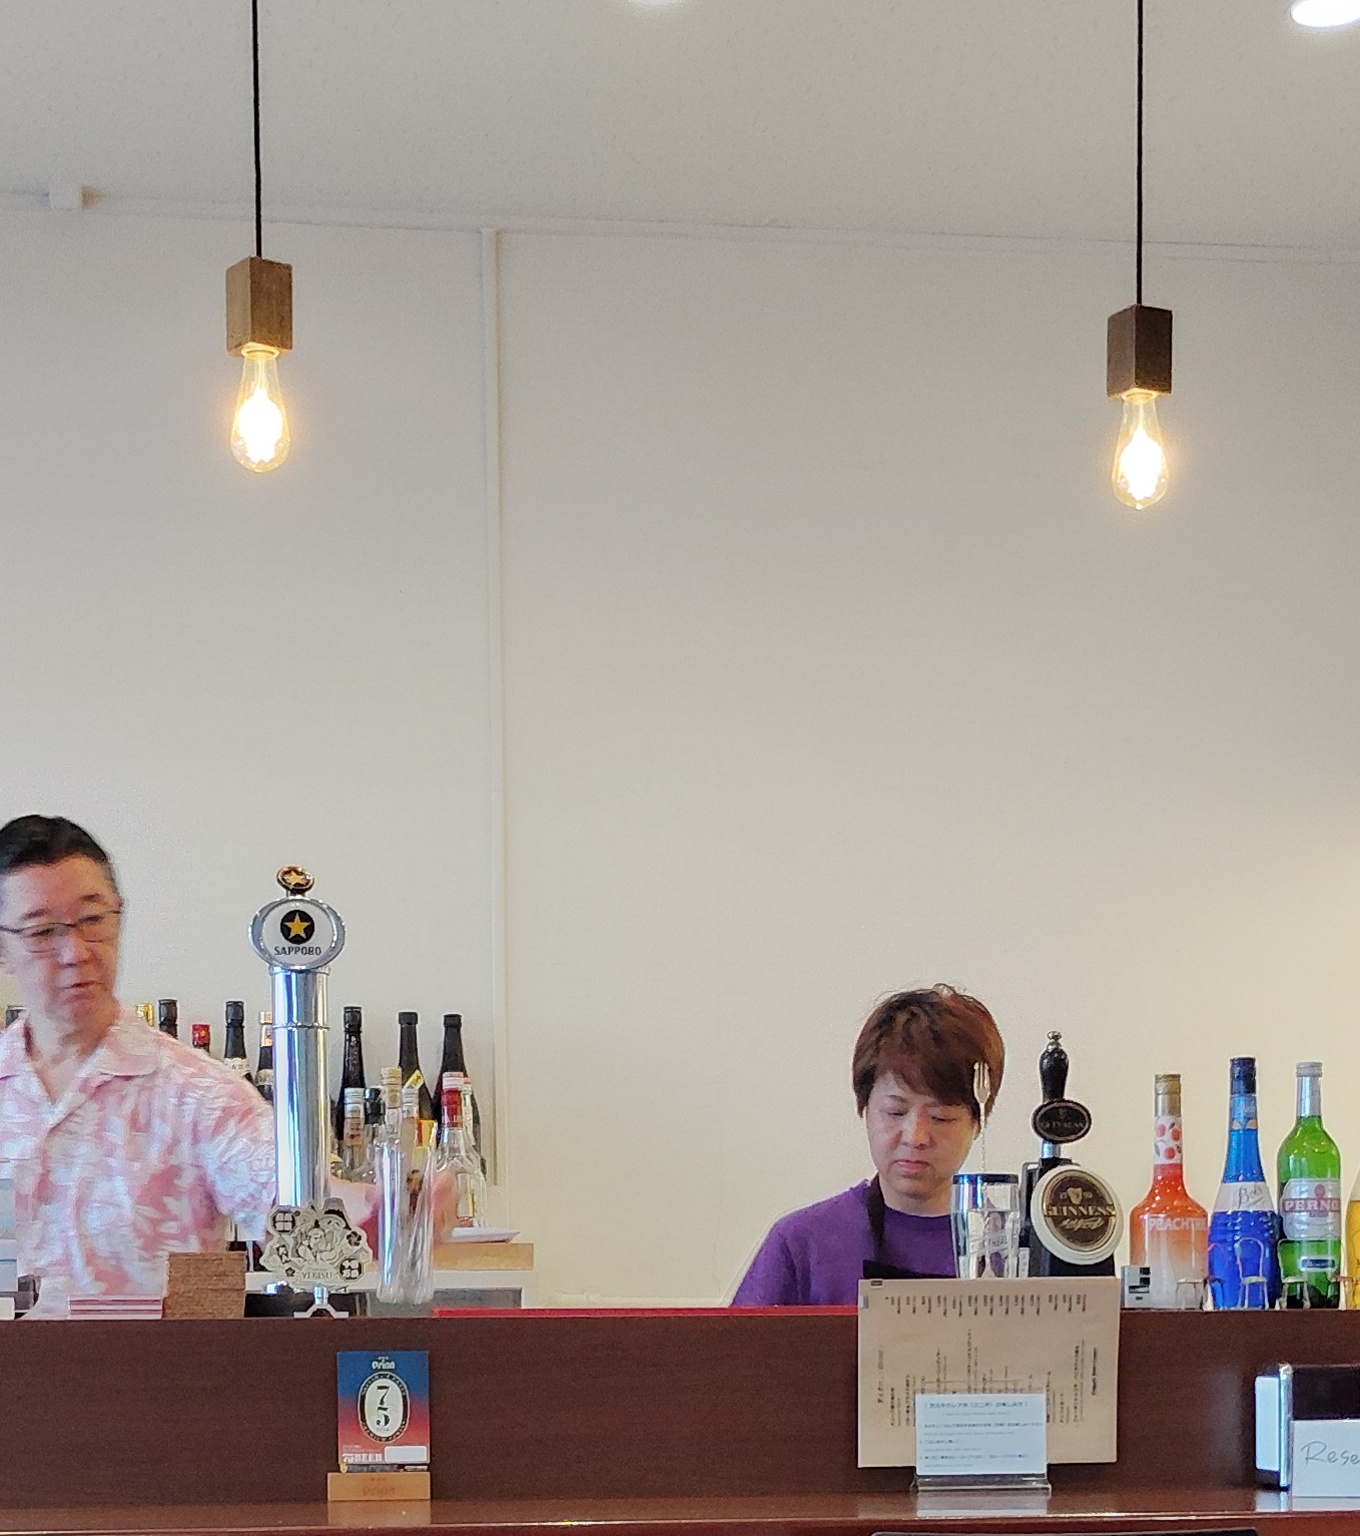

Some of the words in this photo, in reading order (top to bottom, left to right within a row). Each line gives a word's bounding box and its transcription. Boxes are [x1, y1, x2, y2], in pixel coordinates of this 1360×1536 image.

[274, 946, 322, 955] SAPPORO
[1045, 1205, 1116, 1217] GUINNESS
[1285, 1200, 1340, 1211] PERNO
